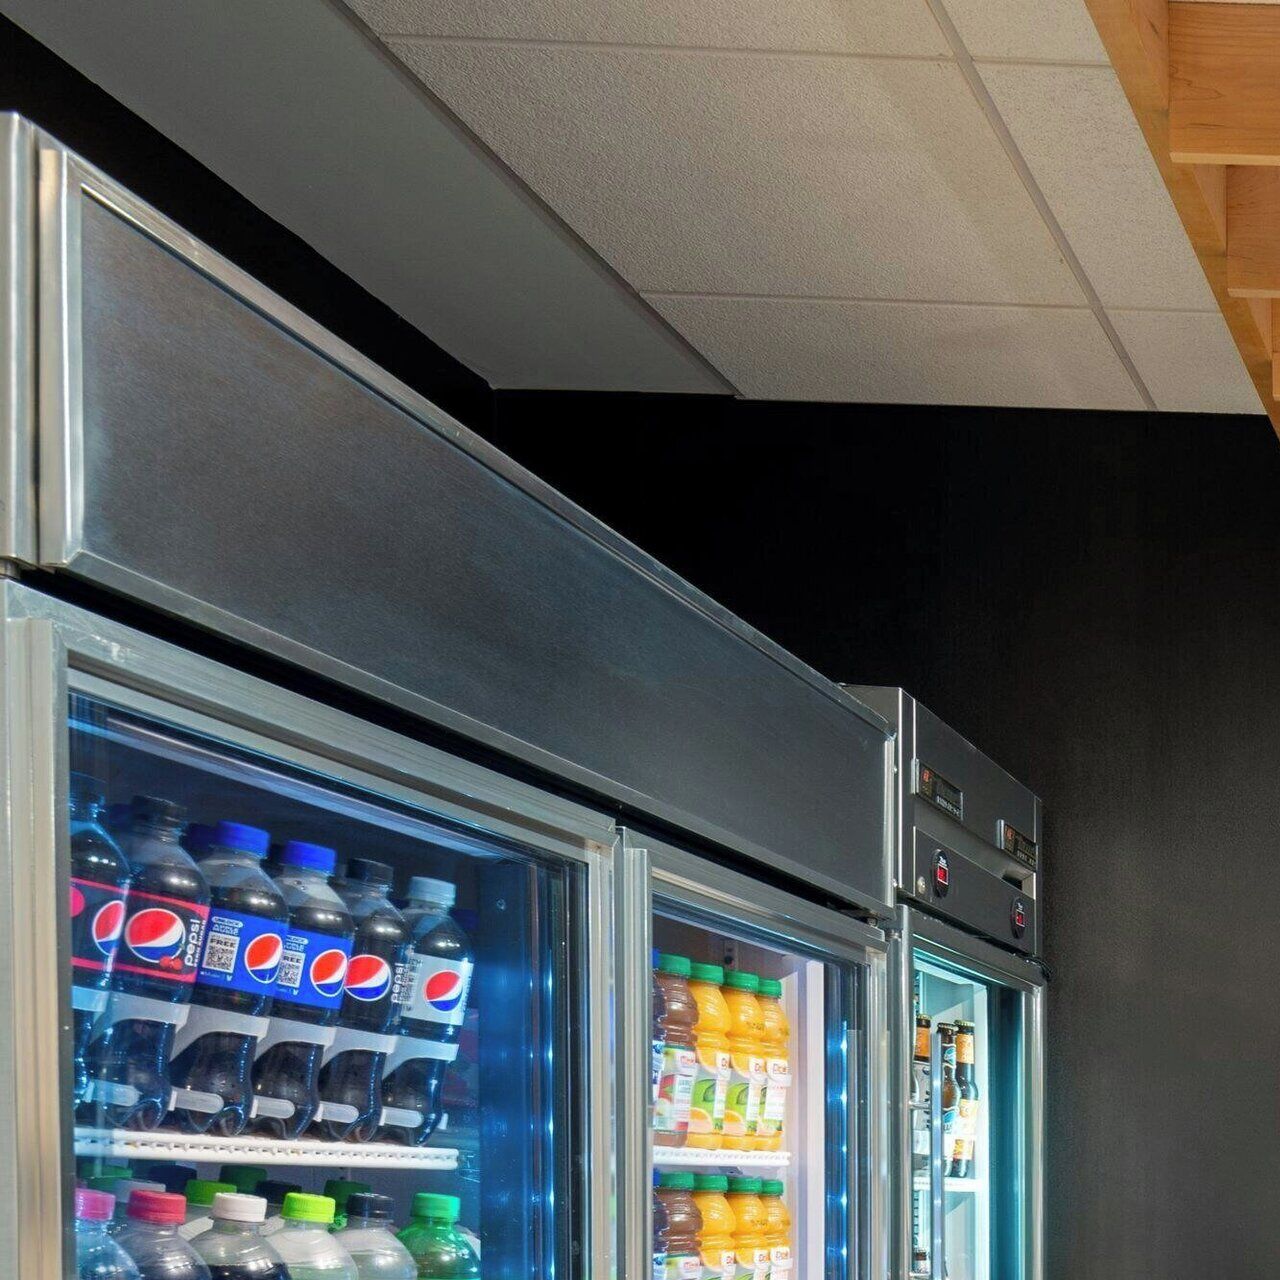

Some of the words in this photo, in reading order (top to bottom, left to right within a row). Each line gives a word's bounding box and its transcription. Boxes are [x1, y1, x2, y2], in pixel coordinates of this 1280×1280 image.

[184, 918, 201, 967] pepsi
[210, 938, 236, 948] FREE
[390, 961, 405, 1004] pepsi
[772, 1062, 788, 1075] Dole
